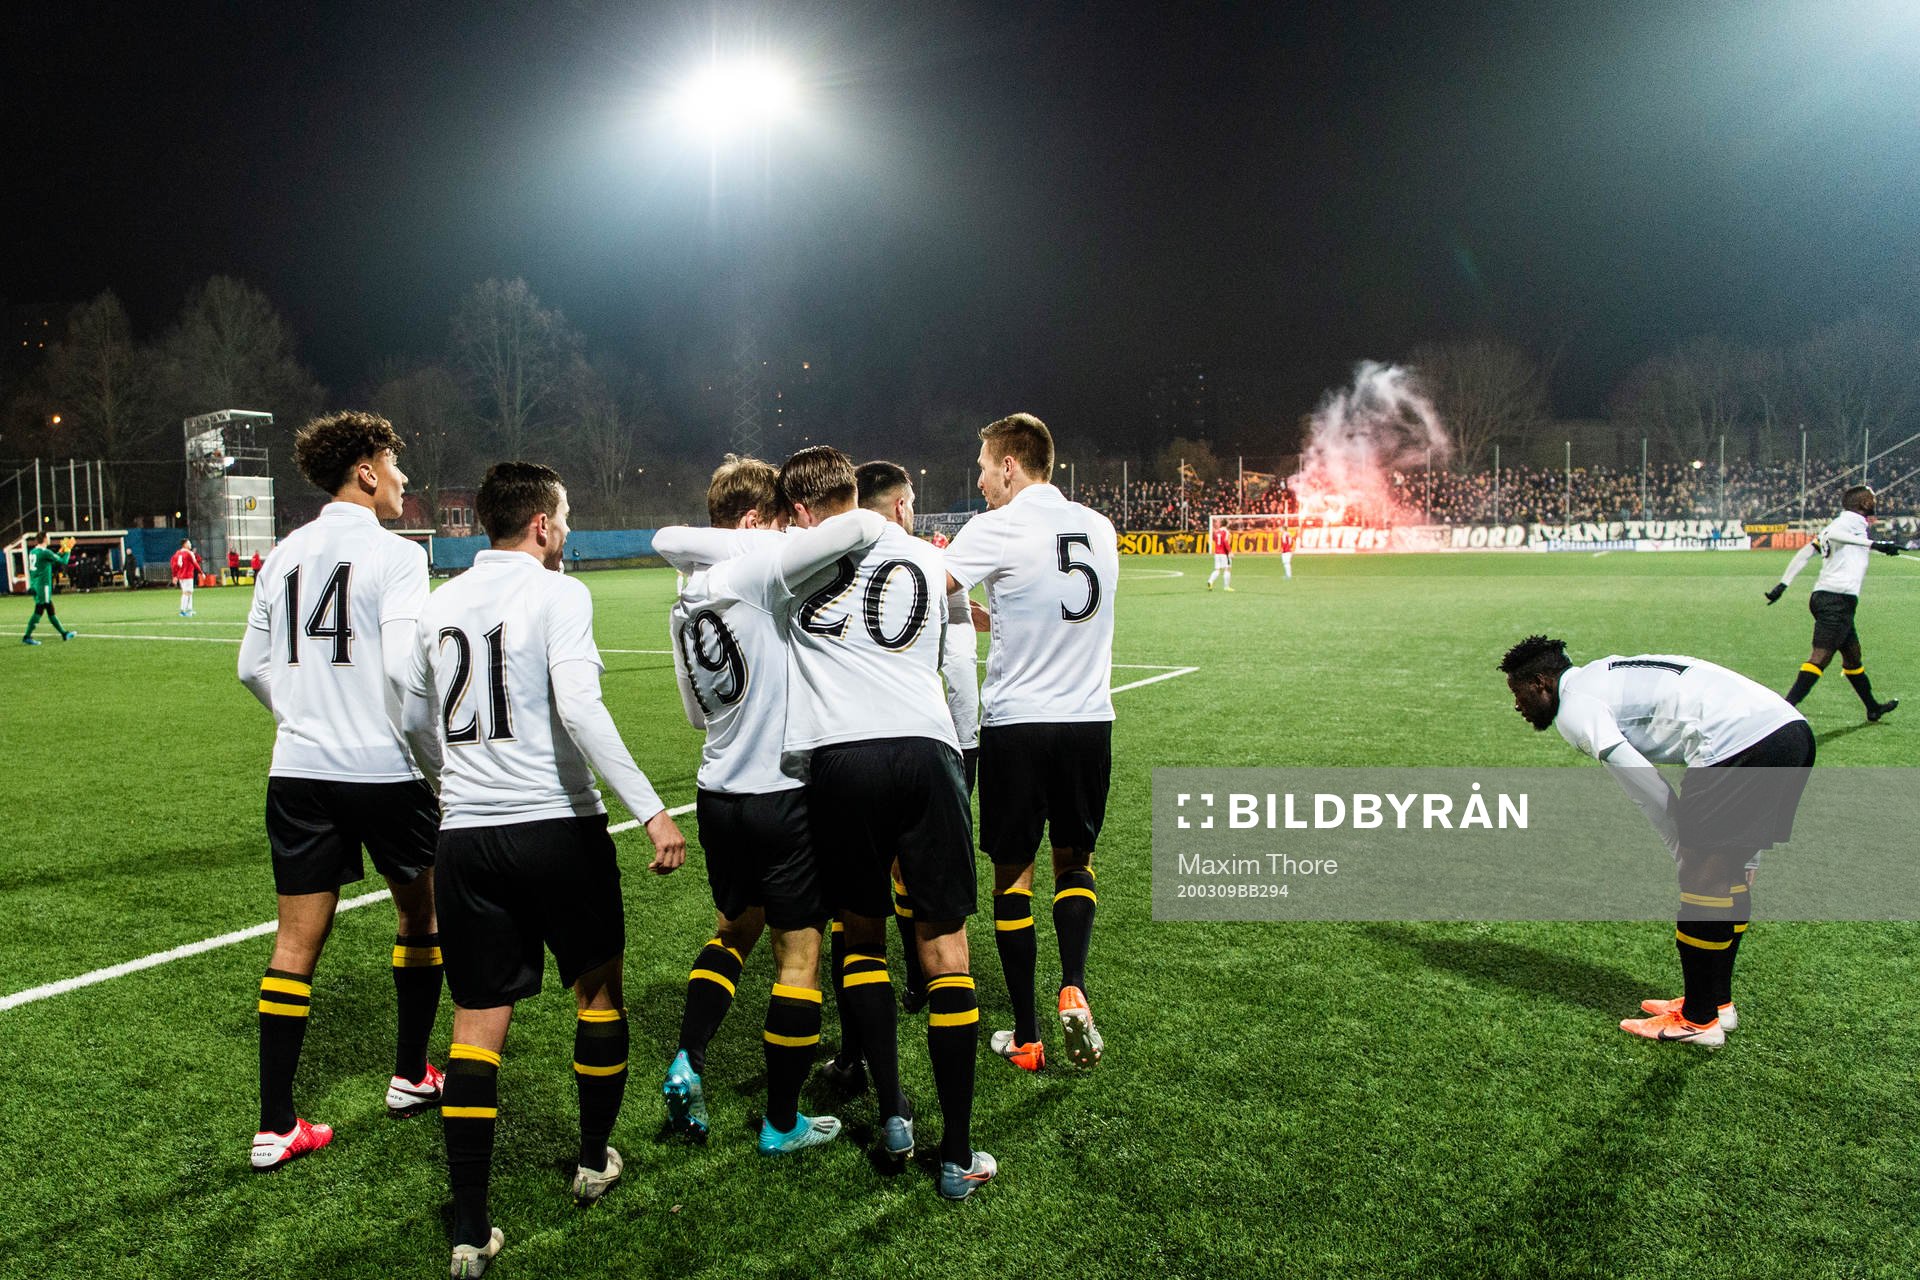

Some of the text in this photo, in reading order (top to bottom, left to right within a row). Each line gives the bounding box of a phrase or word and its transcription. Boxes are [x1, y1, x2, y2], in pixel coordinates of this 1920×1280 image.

[1124, 533, 1165, 555] SOL
[1452, 525, 1526, 547] NORD
[1534, 520, 1746, 541] IVAN TURINA
[284, 562, 355, 667] 14
[799, 555, 930, 653] 20
[1057, 533, 1102, 624] 5
[438, 621, 518, 746] 21
